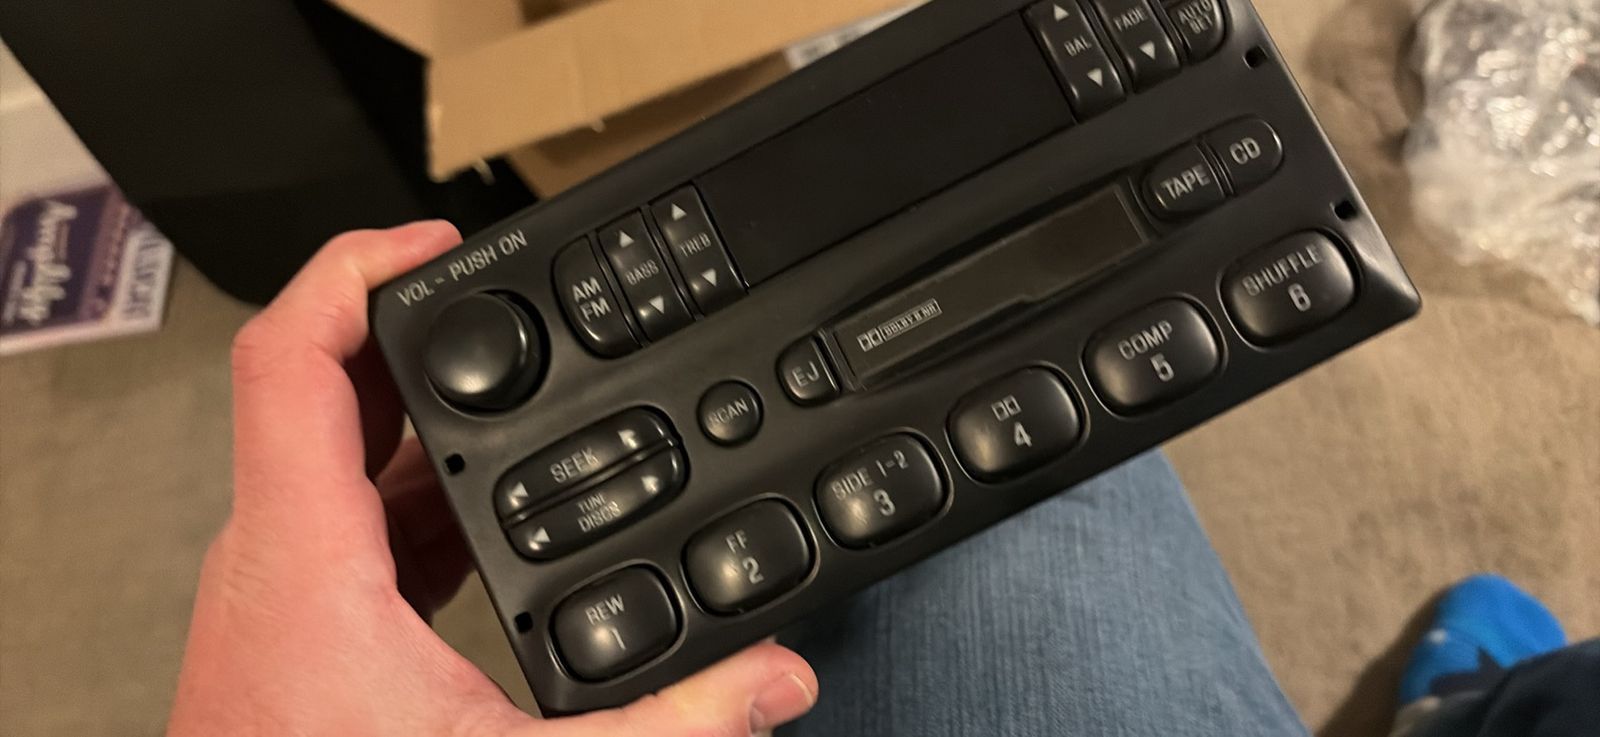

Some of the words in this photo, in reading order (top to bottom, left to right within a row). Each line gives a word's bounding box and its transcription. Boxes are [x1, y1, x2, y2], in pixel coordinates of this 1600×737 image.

[1113, 7, 1147, 32] FADE
[1178, 0, 1212, 24] AUTO
[1064, 36, 1092, 57] BAL
[1229, 137, 1261, 164] CD
[1160, 164, 1211, 199] TAPE
[397, 283, 435, 307] VOL
[448, 247, 498, 281] PUSH
[500, 228, 528, 255] ON
[1242, 244, 1322, 297] SHUFFLE
[571, 276, 603, 302] AM
[1287, 283, 1312, 312] 6
[580, 296, 612, 323] FM
[1117, 319, 1174, 361] COMP
[792, 360, 820, 388] EJ
[1150, 353, 1175, 382] 5
[708, 397, 749, 426] SCAN
[1012, 421, 1033, 448] 4
[550, 447, 601, 483] SEEK
[830, 467, 873, 501] SIDE
[873, 488, 896, 517] 3
[725, 530, 749, 555] FF
[741, 557, 765, 585] 2
[585, 595, 625, 626] REW
[610, 628, 627, 650] 1
